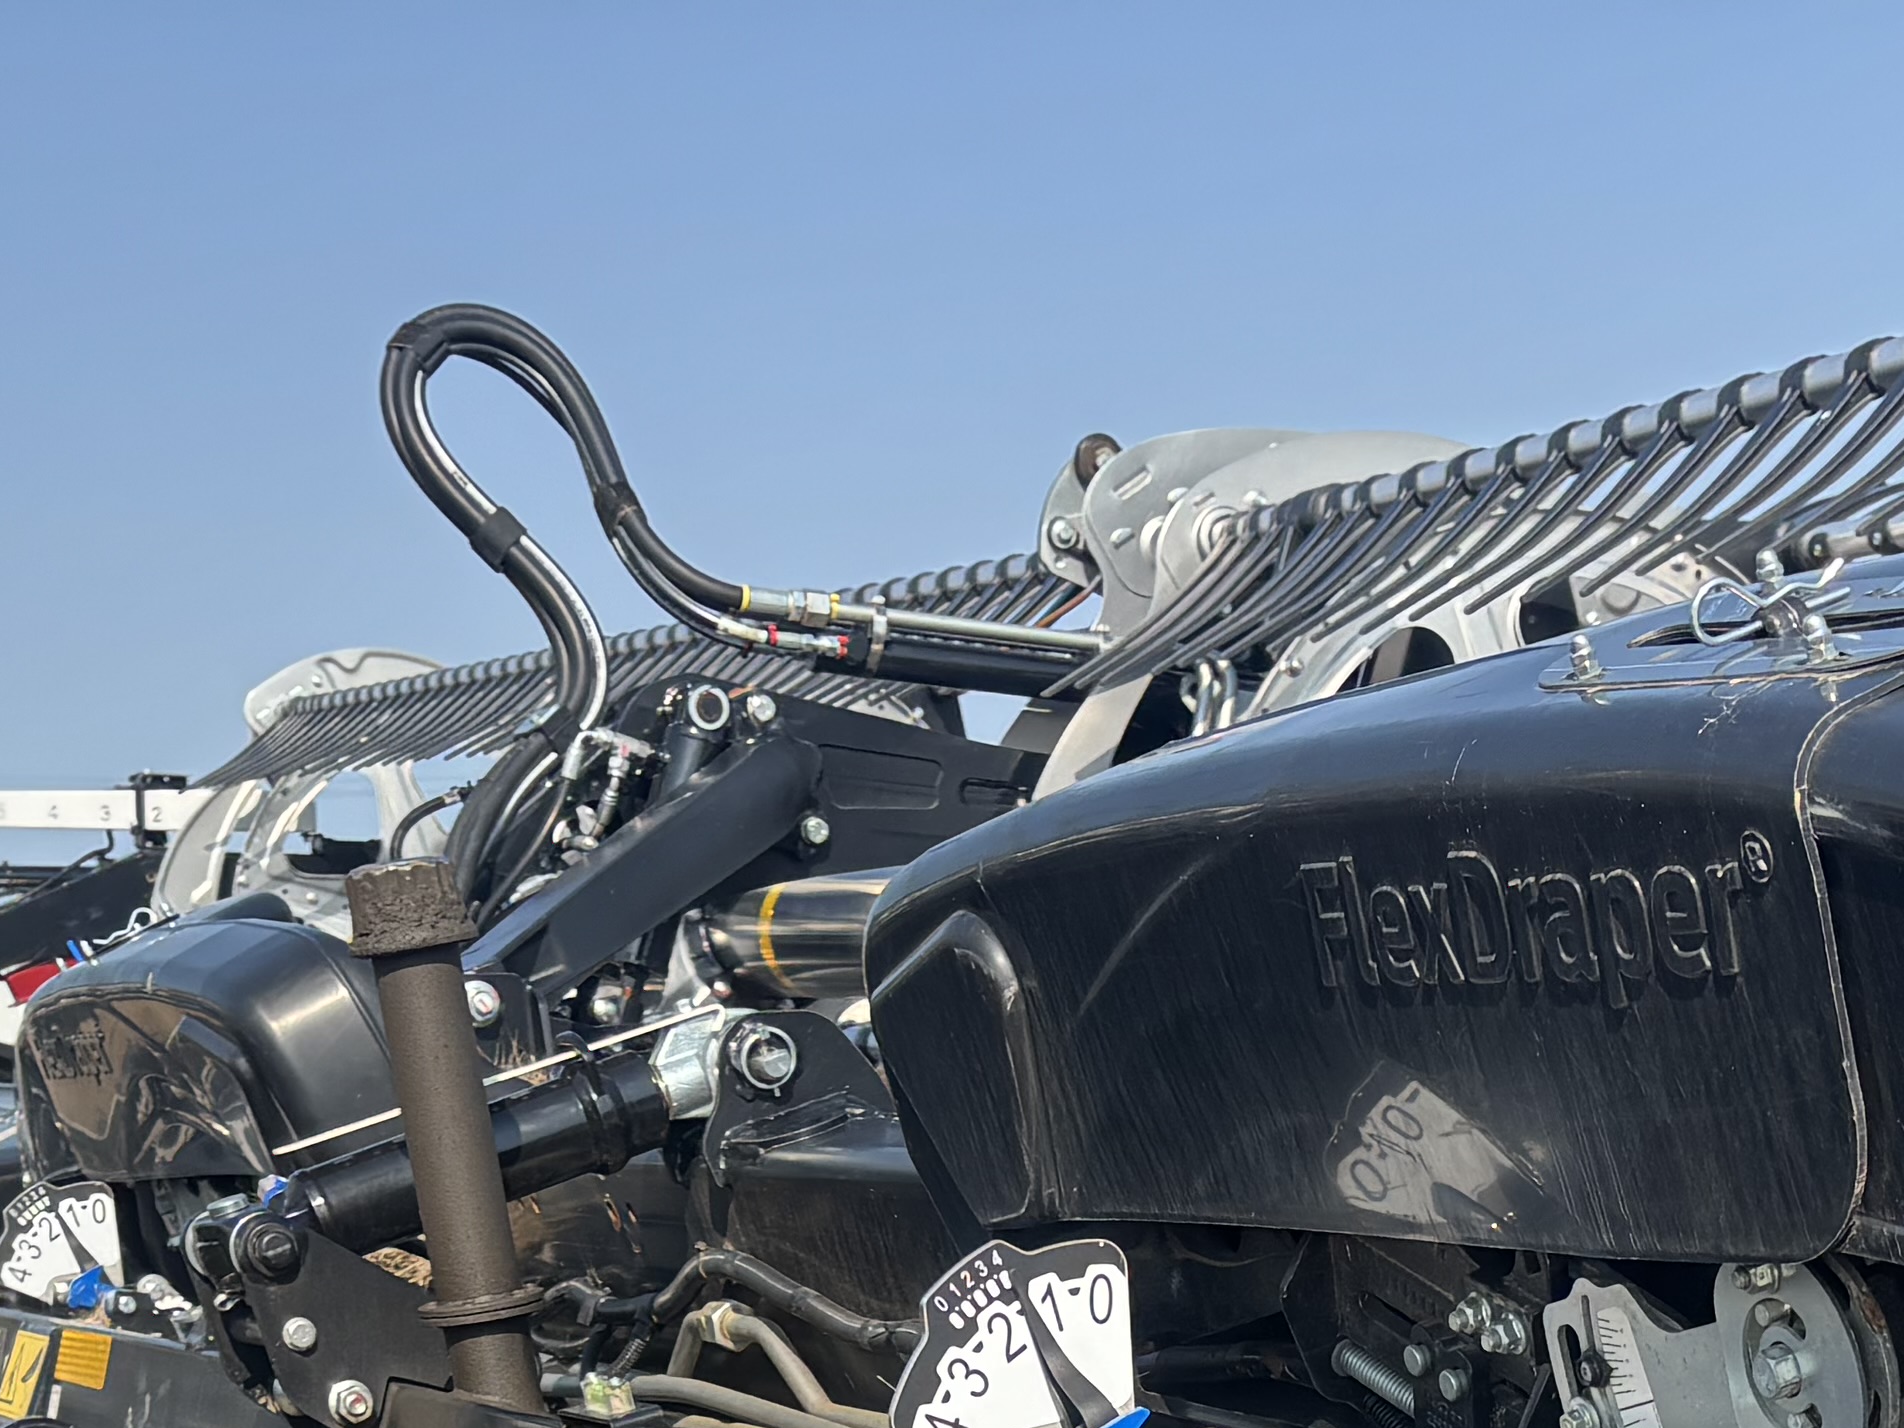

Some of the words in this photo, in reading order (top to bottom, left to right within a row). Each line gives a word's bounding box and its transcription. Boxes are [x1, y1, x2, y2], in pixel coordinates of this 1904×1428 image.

[47, 804, 59, 820] 4
[99, 804, 112, 822] 3
[151, 806, 163, 823] 2
[66, 1203, 81, 1228] 1
[92, 1198, 107, 1224] 0
[38, 1217, 62, 1243] 2
[18, 1239, 42, 1260] 3
[8, 1266, 33, 1283] 4
[933, 1295, 949, 1312] 0
[949, 1282, 962, 1297] 1
[960, 1270, 975, 1289] 2
[974, 1259, 989, 1277] 3
[991, 1249, 1004, 1267] 4
[947, 1357, 990, 1398] 3
[986, 1312, 1028, 1364] 2
[1040, 1281, 1064, 1333] 1
[1089, 1273, 1113, 1325] 0
